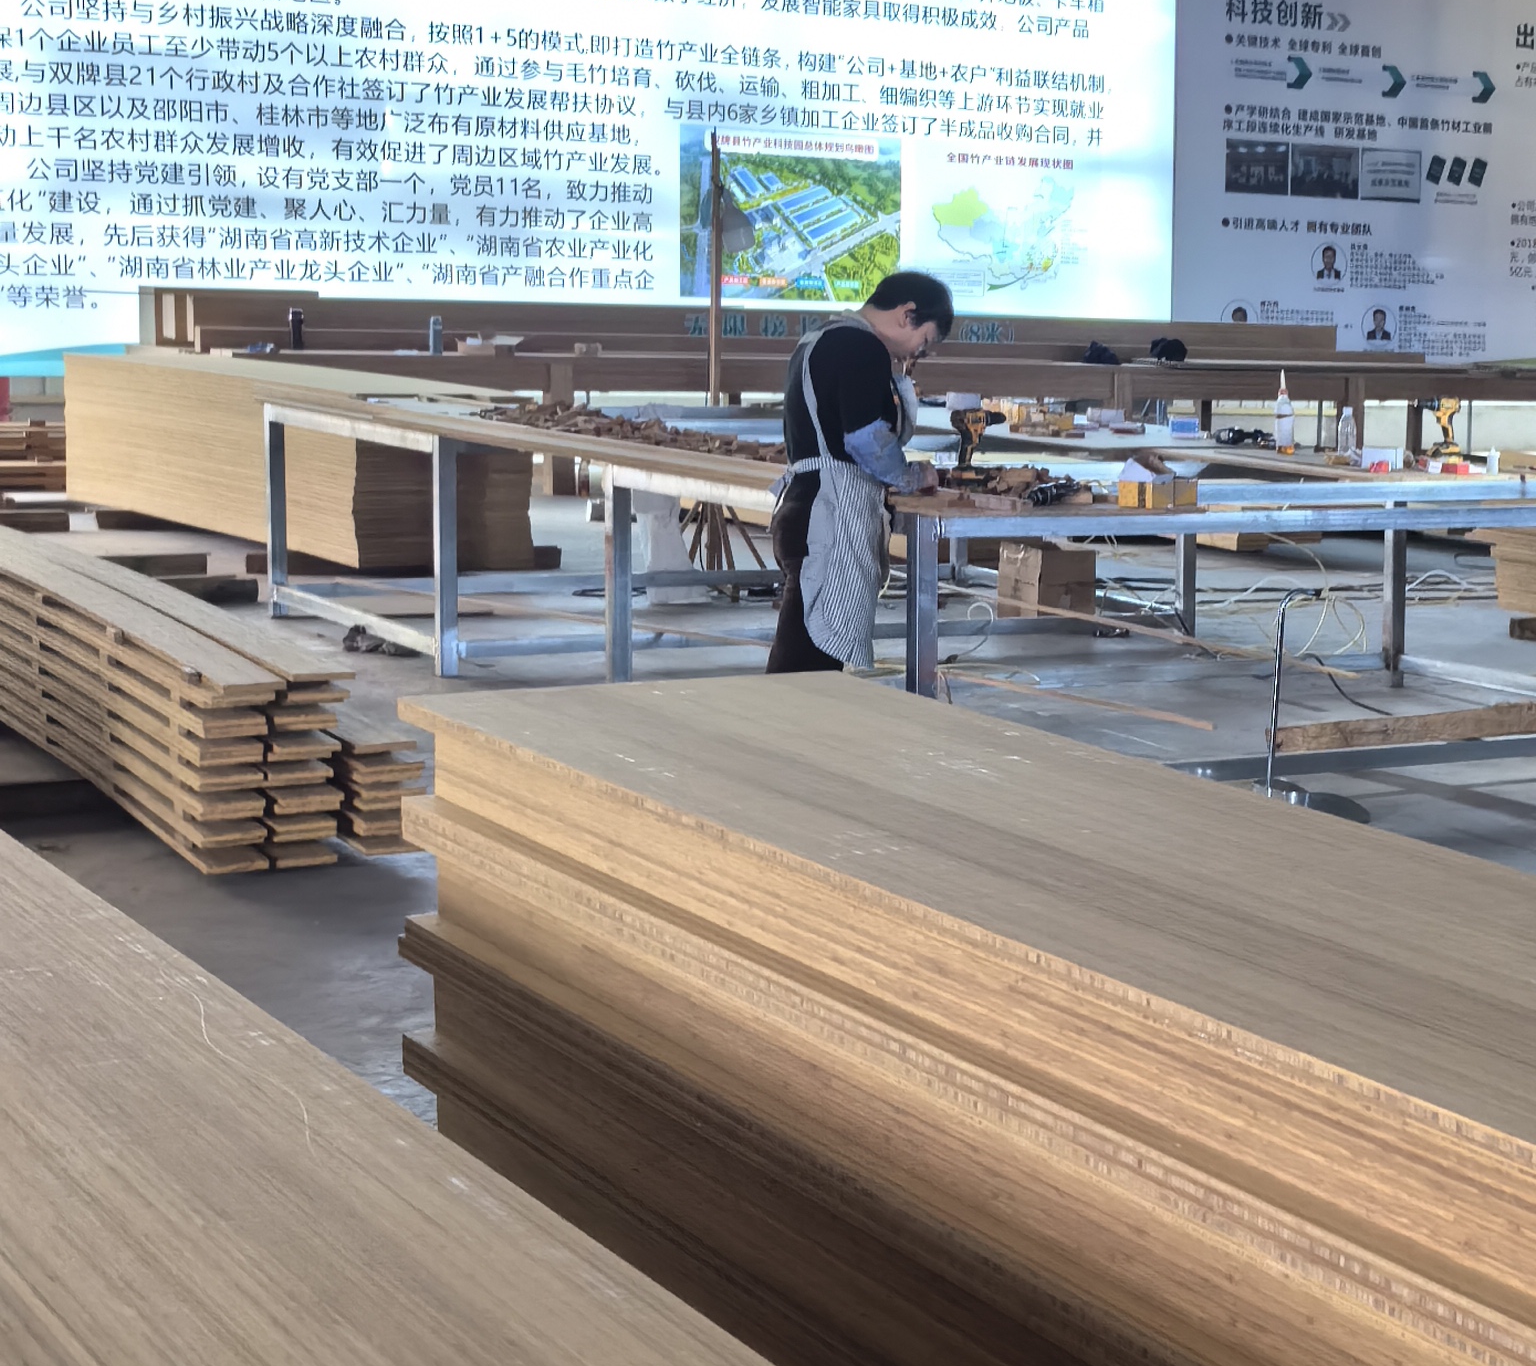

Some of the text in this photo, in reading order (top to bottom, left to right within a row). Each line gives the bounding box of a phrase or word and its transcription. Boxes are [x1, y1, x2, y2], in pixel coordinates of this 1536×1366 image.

[946, 152, 1074, 171] 全国竹产业链发展现状图
